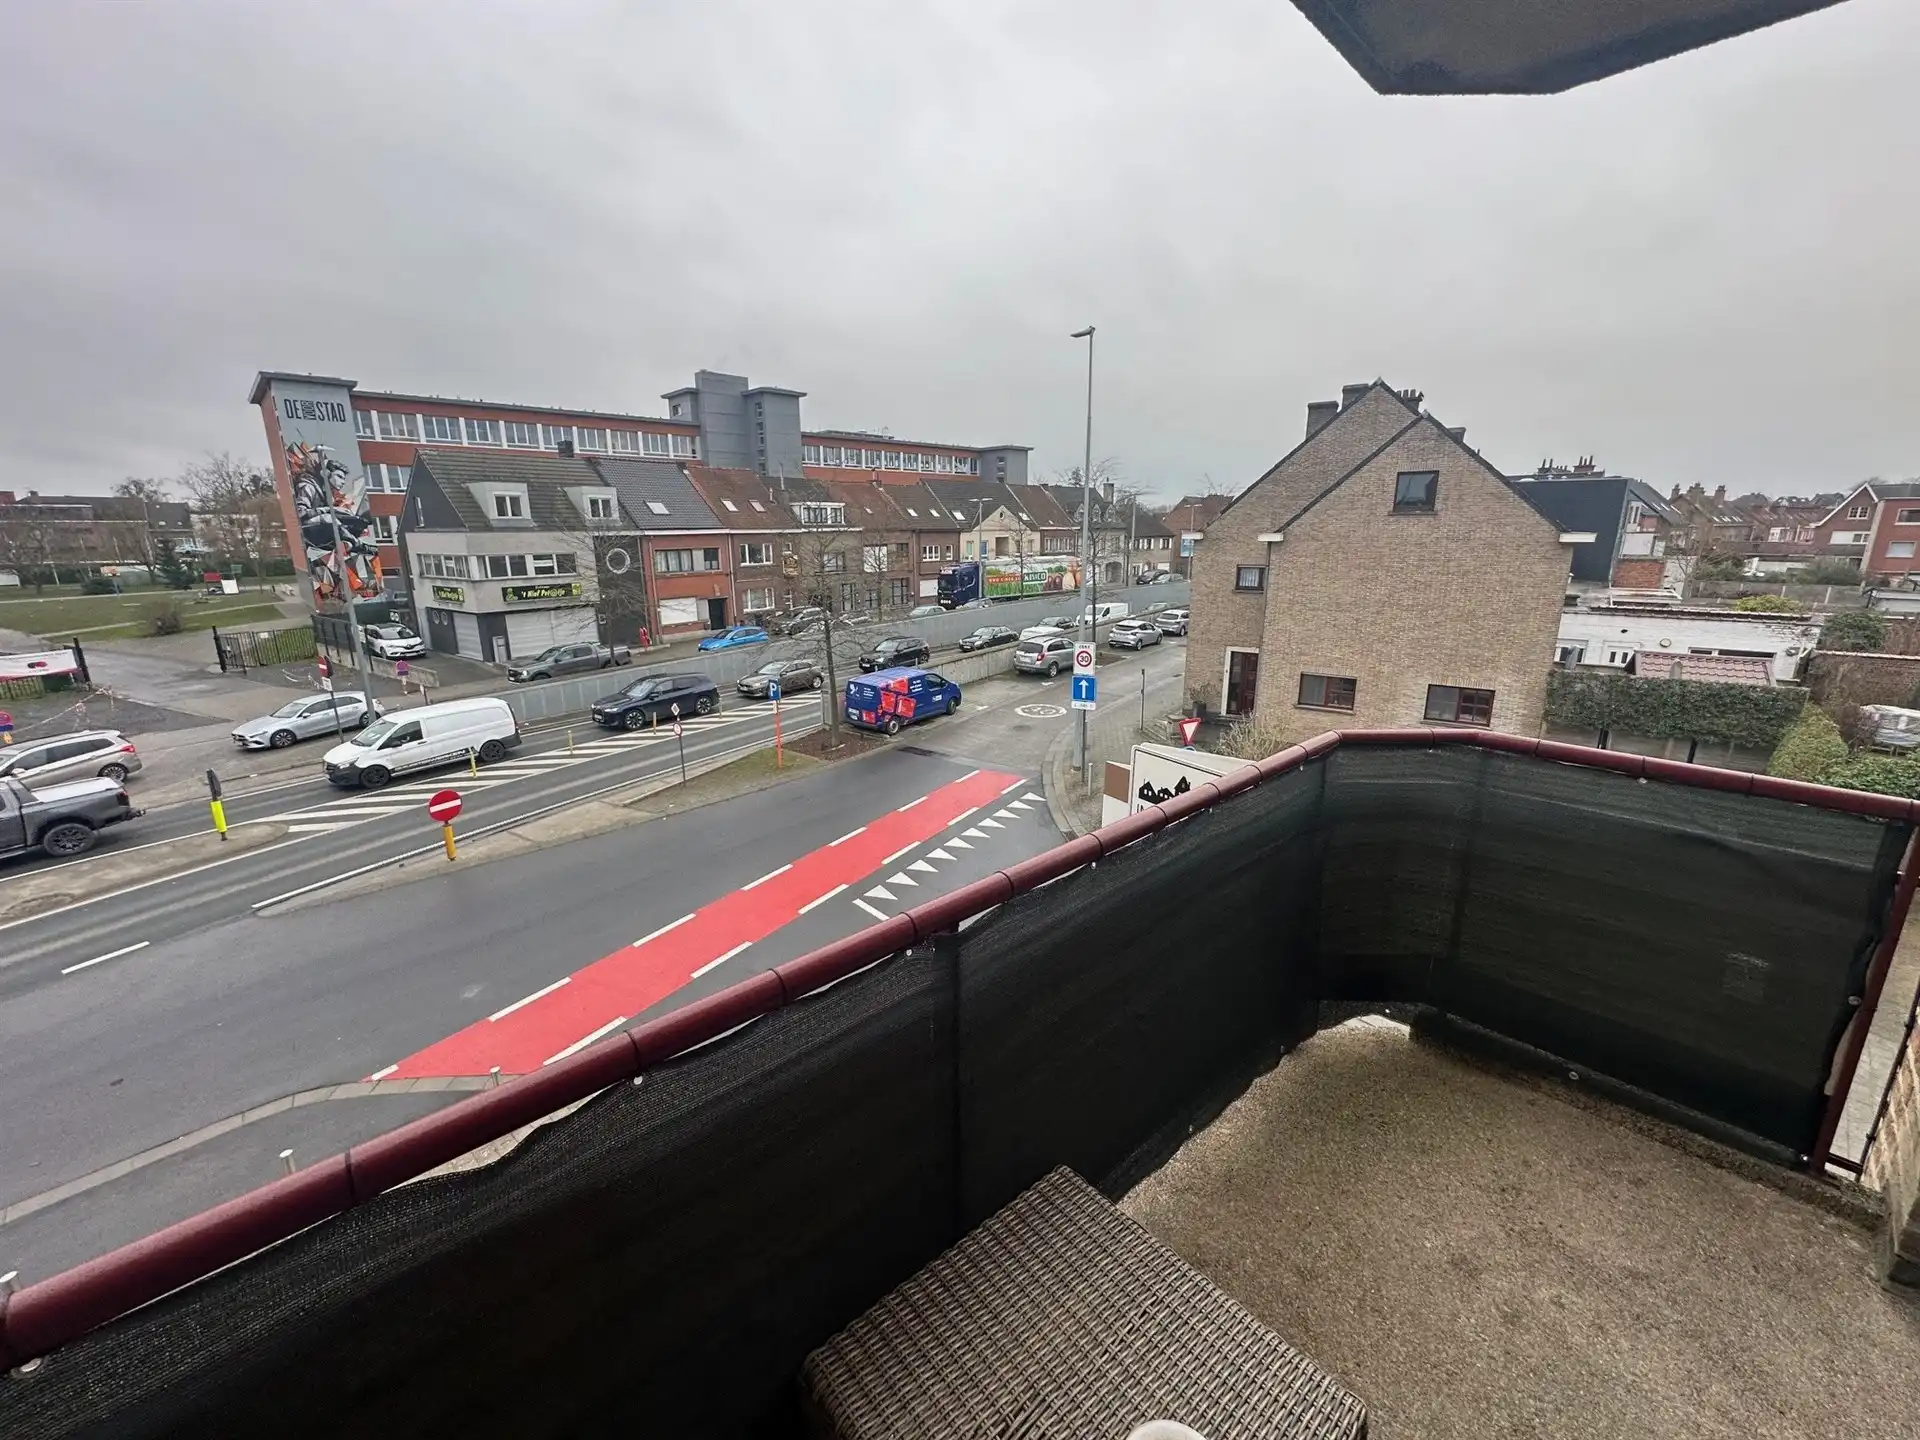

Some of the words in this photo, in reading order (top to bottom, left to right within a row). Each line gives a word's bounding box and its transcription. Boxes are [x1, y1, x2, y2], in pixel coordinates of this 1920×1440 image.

[284, 399, 301, 419] DE
[316, 401, 346, 422] STAD
[1080, 655, 1090, 663] 30
[770, 682, 777, 696] P
